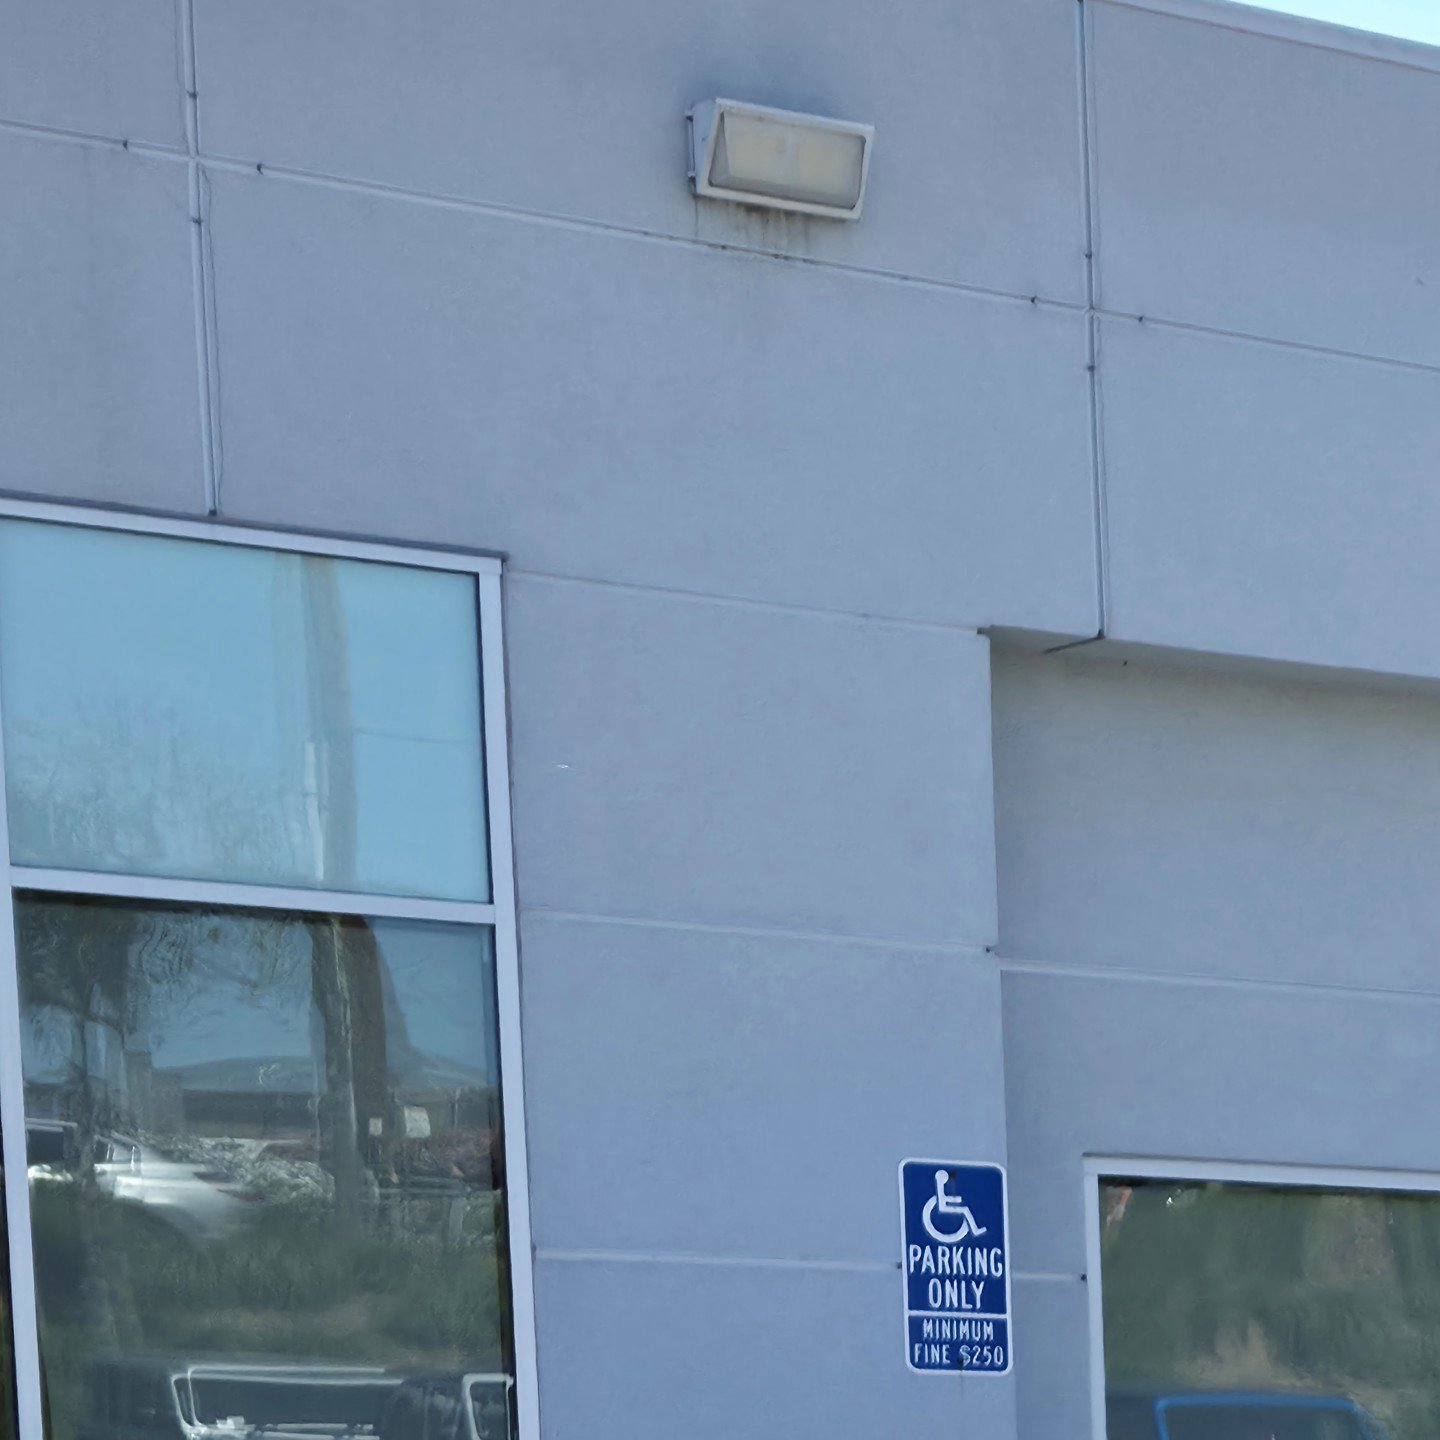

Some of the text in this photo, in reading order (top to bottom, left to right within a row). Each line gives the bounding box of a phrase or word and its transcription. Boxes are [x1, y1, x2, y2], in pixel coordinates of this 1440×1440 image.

[909, 1243, 1003, 1277] PARKING
[928, 1279, 985, 1309] ONLY
[922, 1318, 994, 1341] MINIMUM
[914, 1343, 1004, 1367] FINE $250
